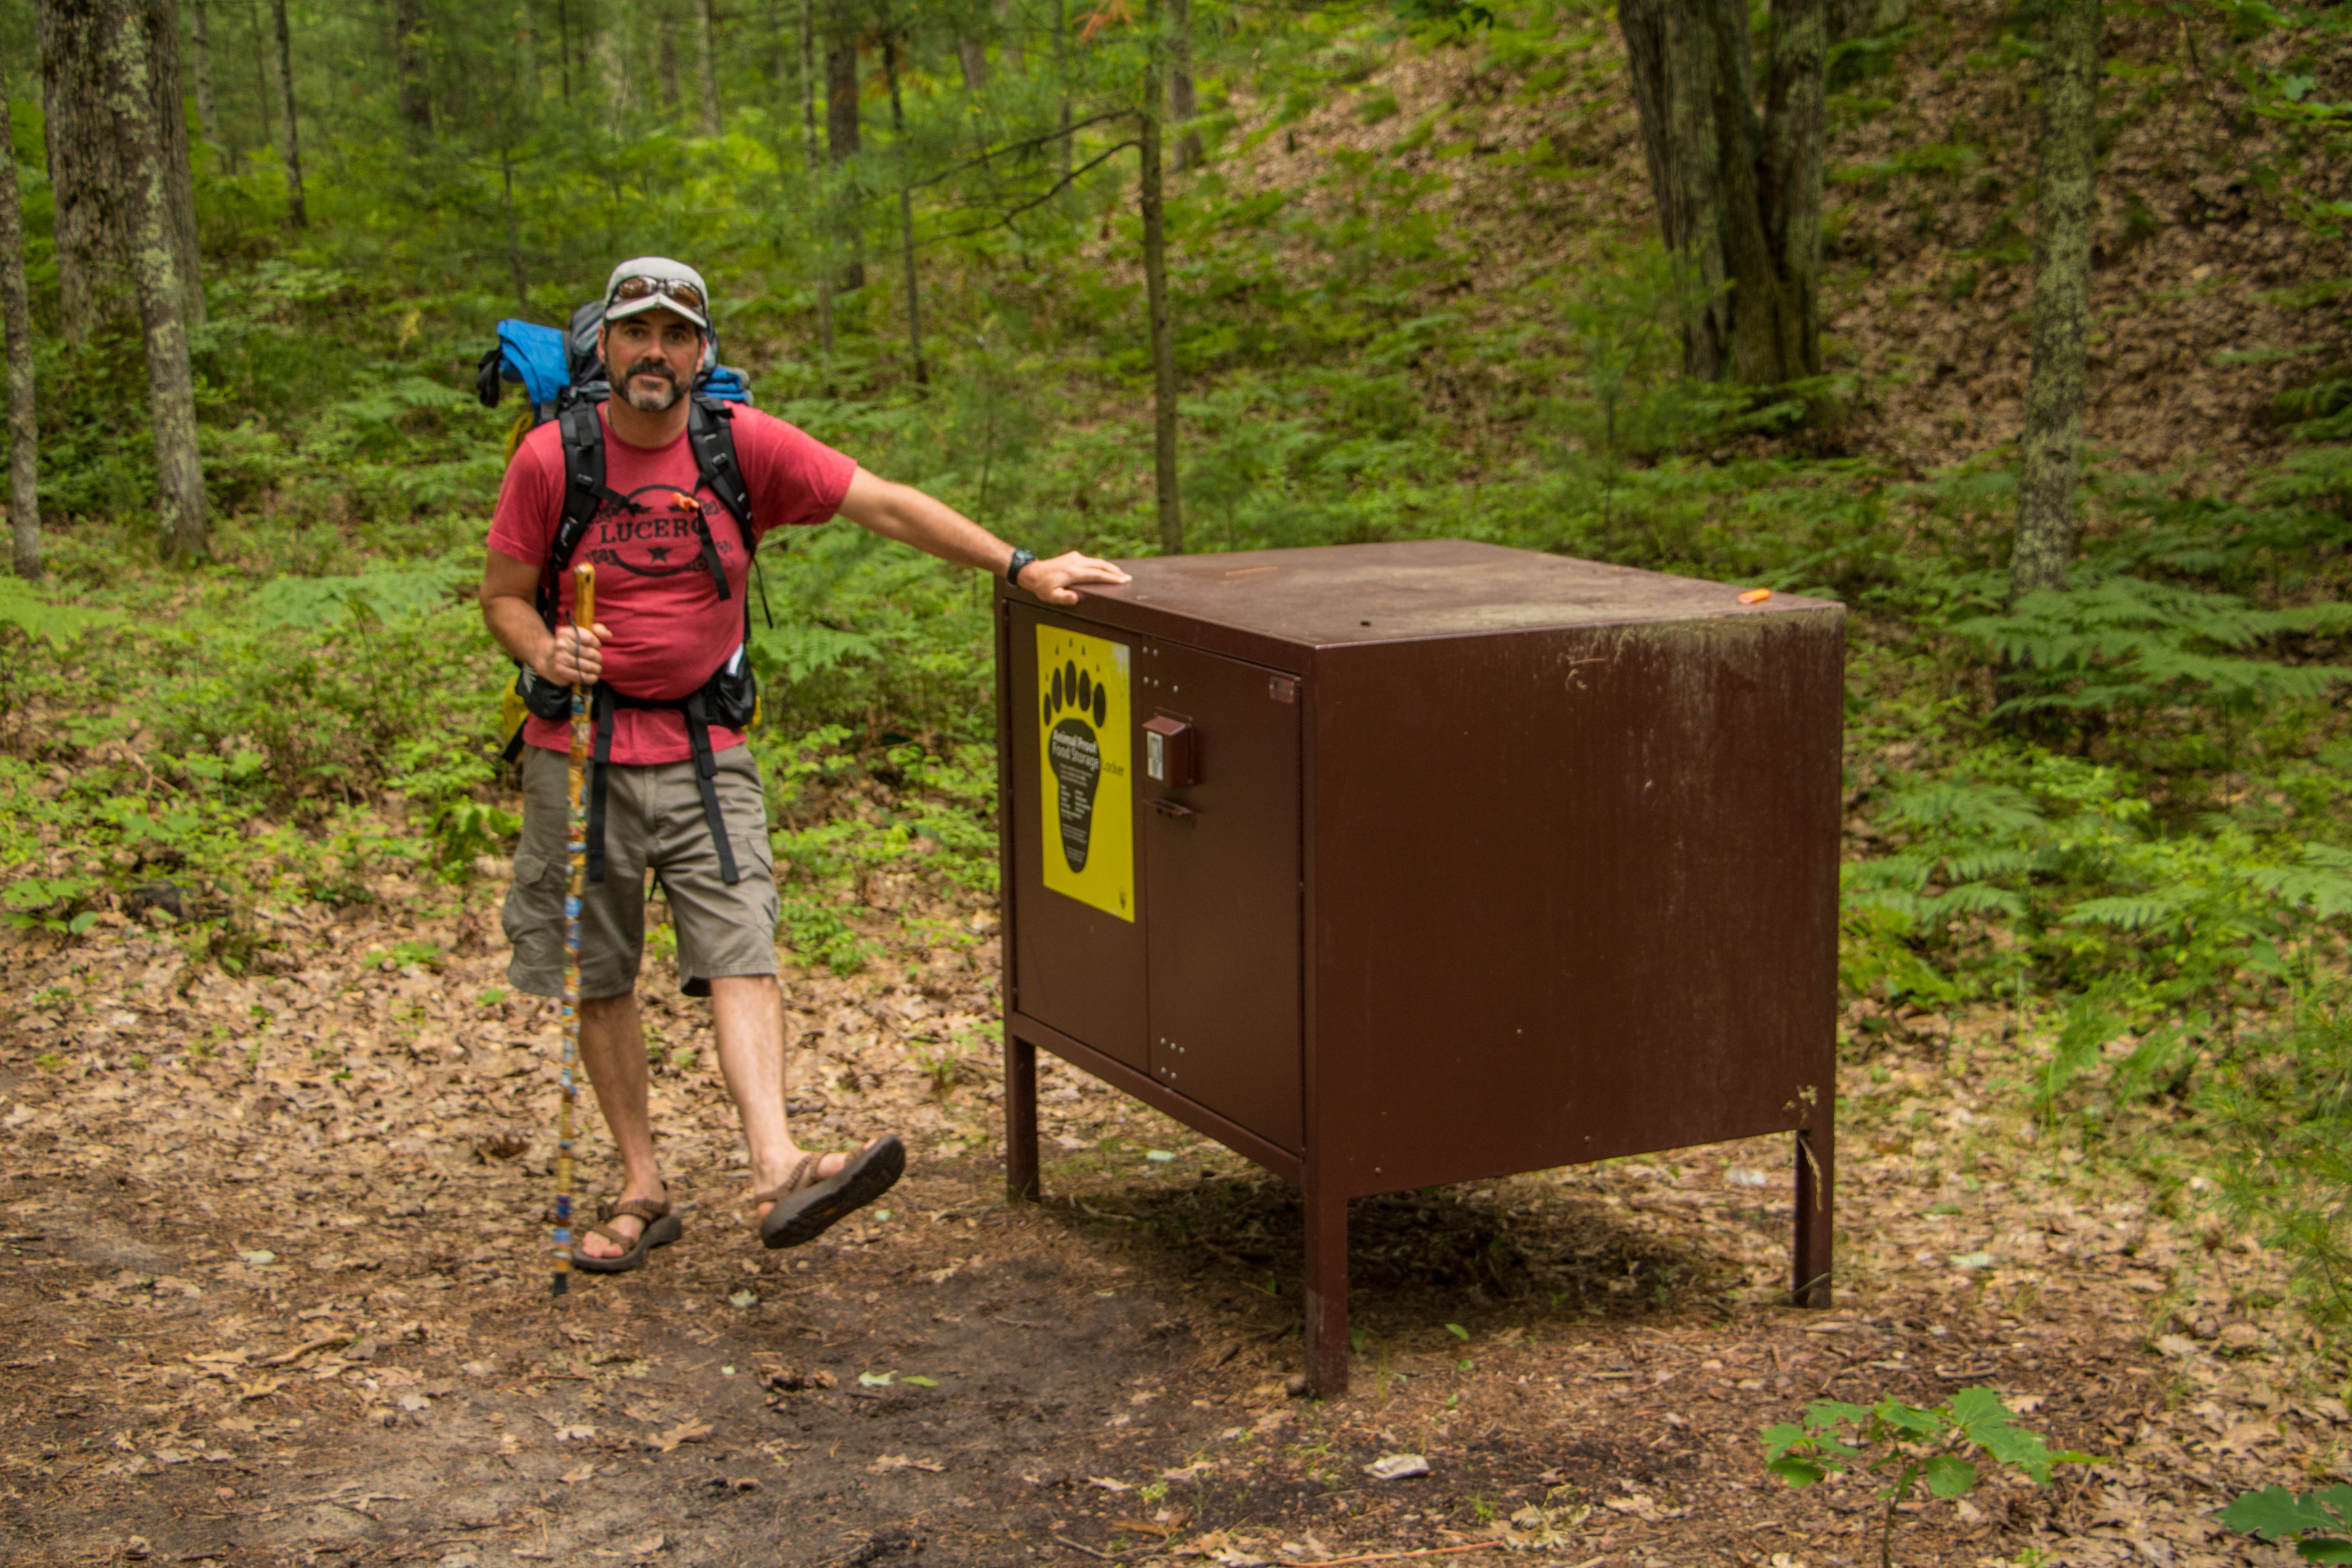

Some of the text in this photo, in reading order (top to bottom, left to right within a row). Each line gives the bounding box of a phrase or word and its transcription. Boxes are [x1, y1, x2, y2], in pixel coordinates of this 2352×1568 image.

[1052, 741, 1071, 760] Food
[1071, 747, 1100, 771] Storage
[1053, 730, 1098, 755] Animal Proof
